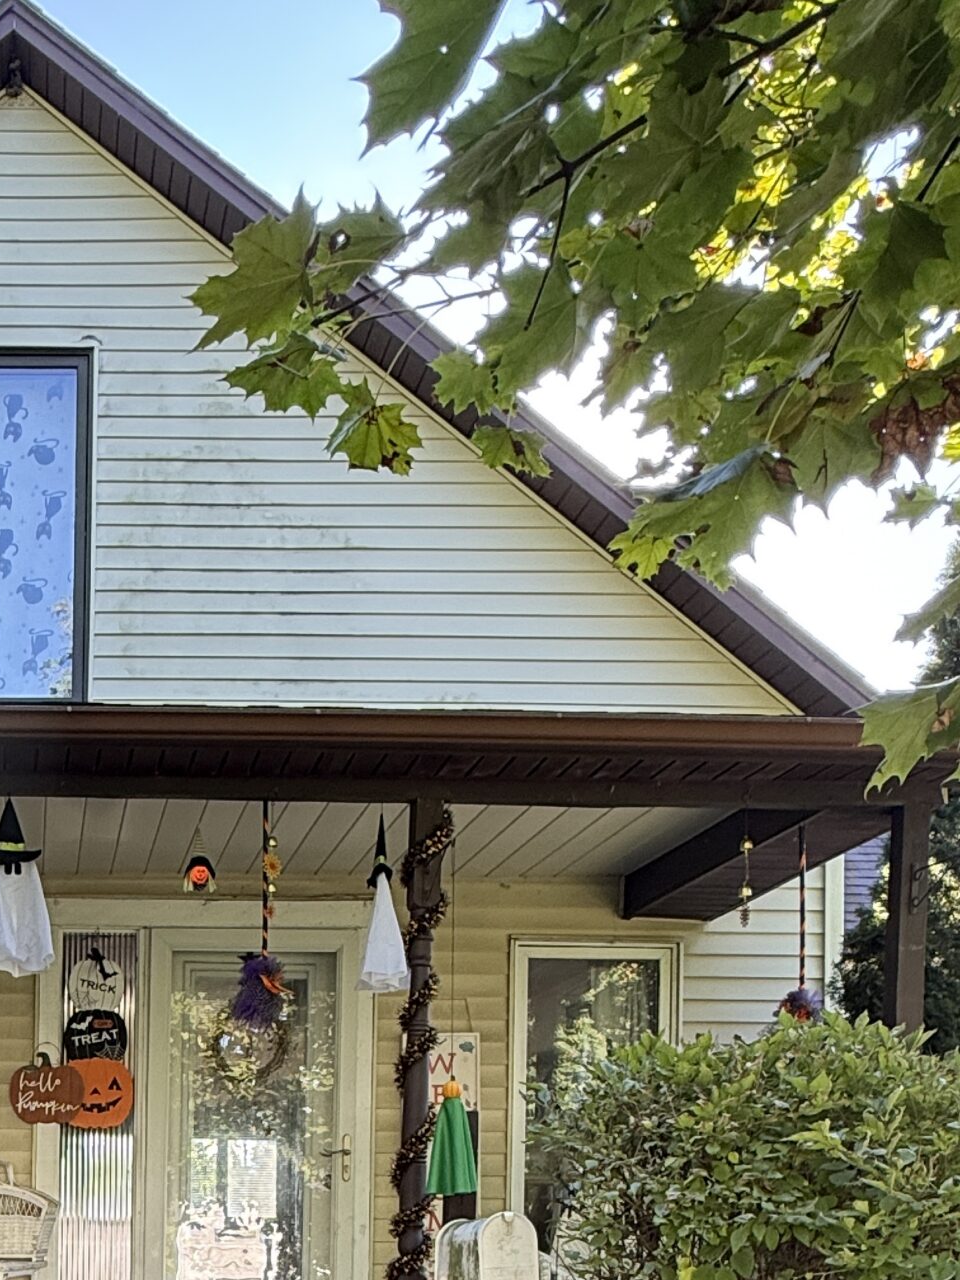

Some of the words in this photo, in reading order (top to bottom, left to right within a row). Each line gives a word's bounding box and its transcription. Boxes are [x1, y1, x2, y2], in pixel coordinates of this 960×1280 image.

[80, 978, 117, 994] TRICK
[71, 1029, 119, 1046] TREAT
[20, 1071, 61, 1092] hello
